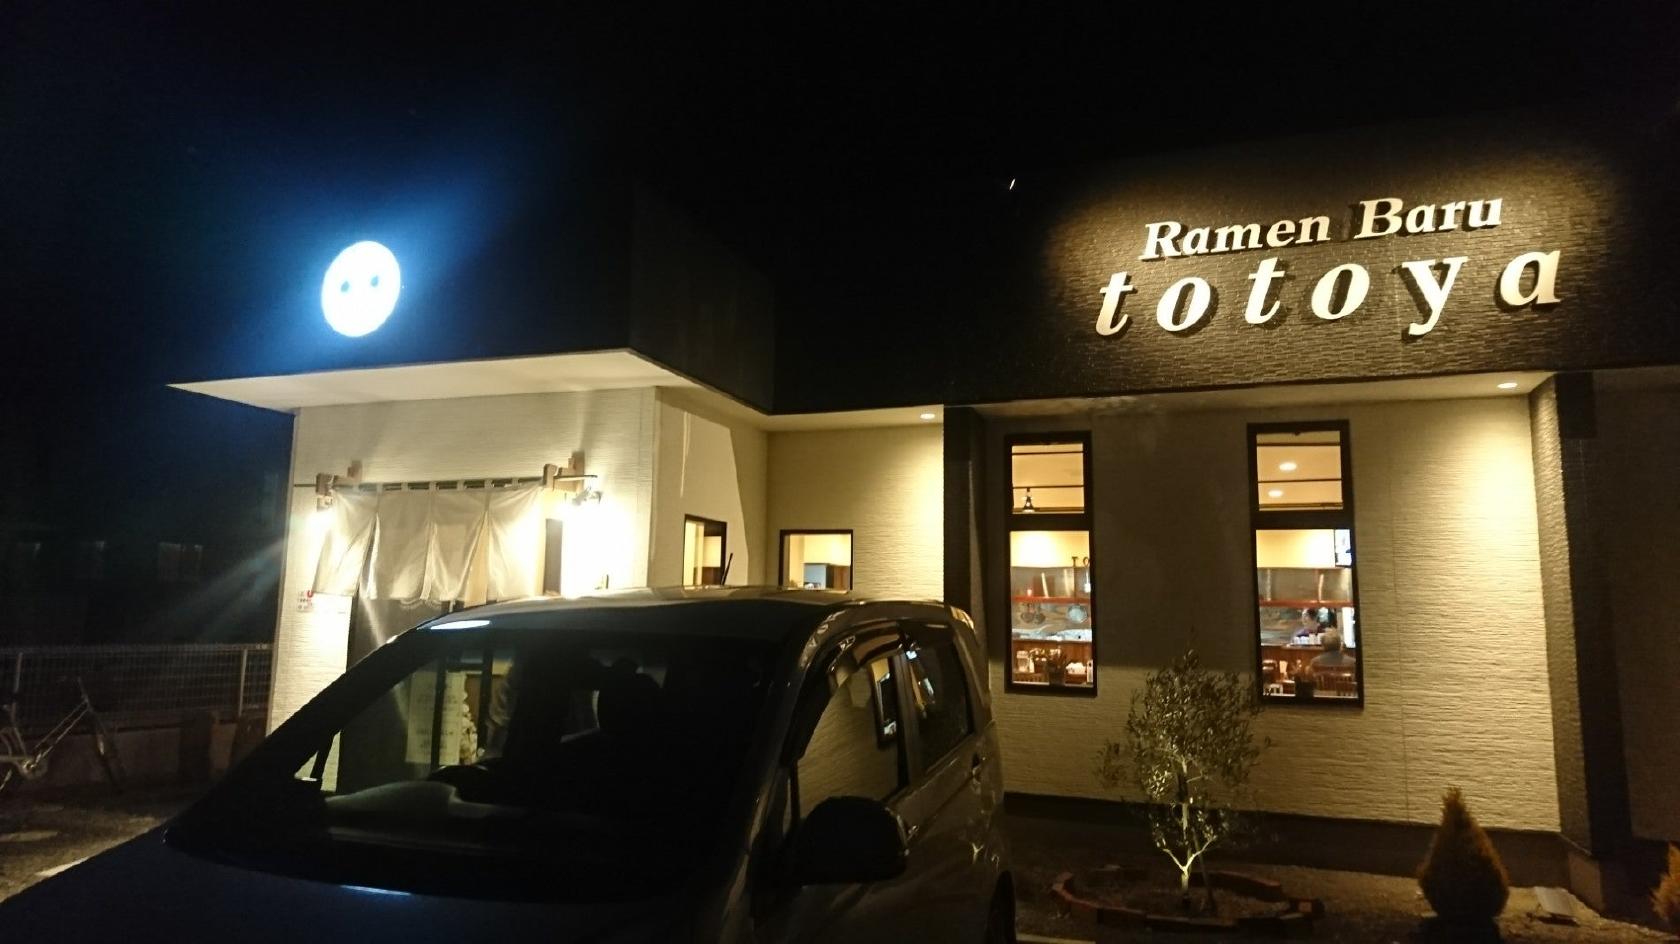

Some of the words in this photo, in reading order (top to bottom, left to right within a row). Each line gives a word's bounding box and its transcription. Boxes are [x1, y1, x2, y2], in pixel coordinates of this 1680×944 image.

[1138, 215, 1331, 261] Ramen
[1353, 197, 1503, 240] Baru
[1095, 249, 1561, 336] totoya
